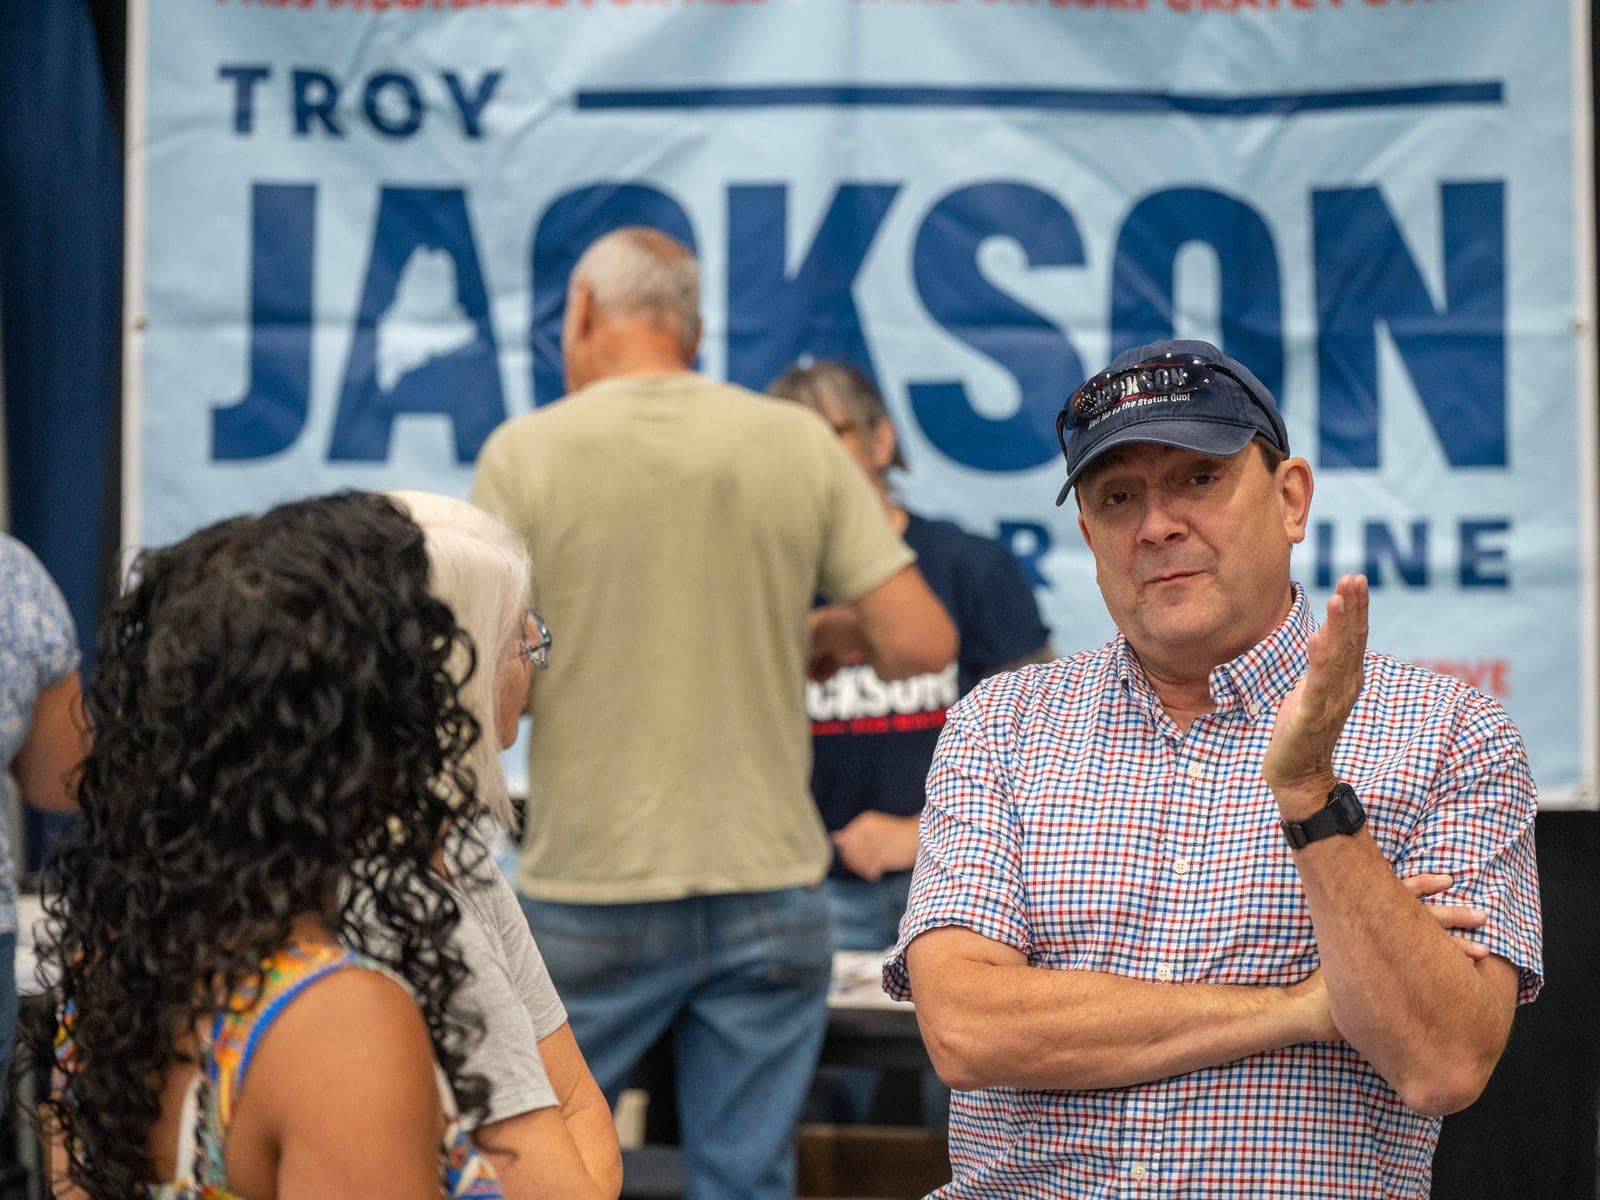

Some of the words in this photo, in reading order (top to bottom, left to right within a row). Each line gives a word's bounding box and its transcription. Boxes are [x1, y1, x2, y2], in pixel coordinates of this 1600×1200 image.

[218, 66, 503, 139] TROY
[210, 179, 1508, 472] JACKSON
[1112, 405, 1121, 415] to
[1122, 400, 1137, 410] the
[1137, 394, 1168, 407] Status
[1170, 392, 1191, 403] Quo!
[1316, 520, 1511, 588] INE
